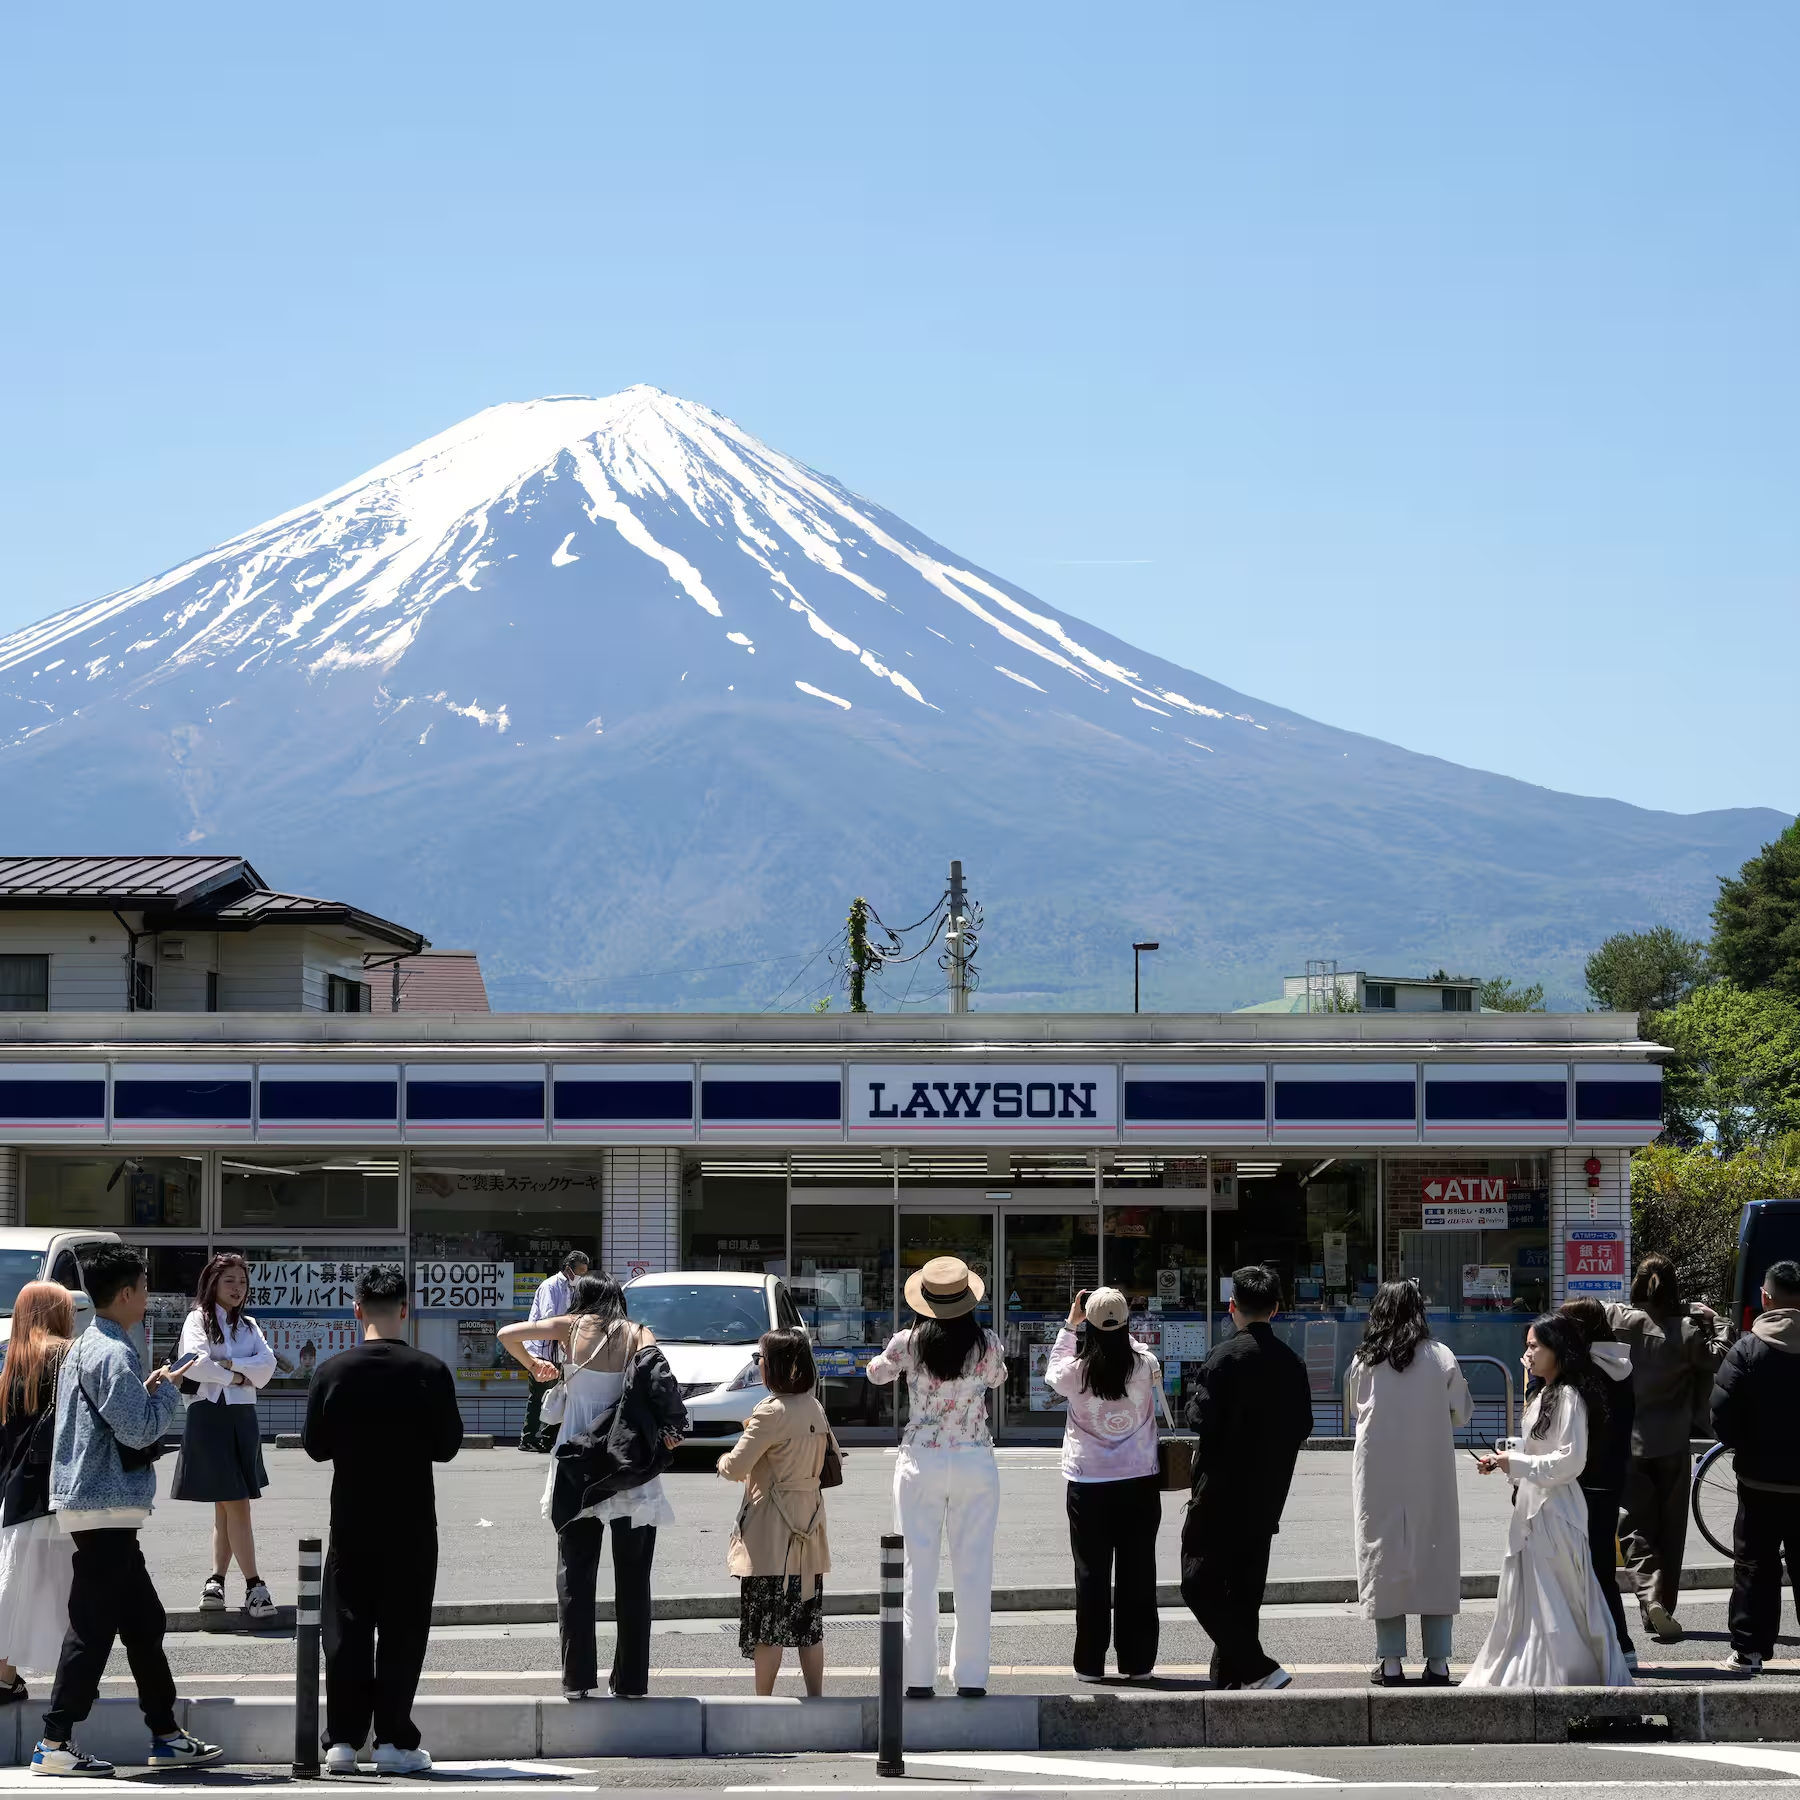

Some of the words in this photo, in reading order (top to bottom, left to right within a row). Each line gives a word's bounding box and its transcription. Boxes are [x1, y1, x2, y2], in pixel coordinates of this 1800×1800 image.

[869, 1082, 1097, 1118] LAWSON
[1443, 1179, 1504, 1200] ATM
[1579, 1244, 1612, 1257] 銀行
[1576, 1259, 1612, 1272] ATM
[1132, 1334, 1155, 1343] TM
